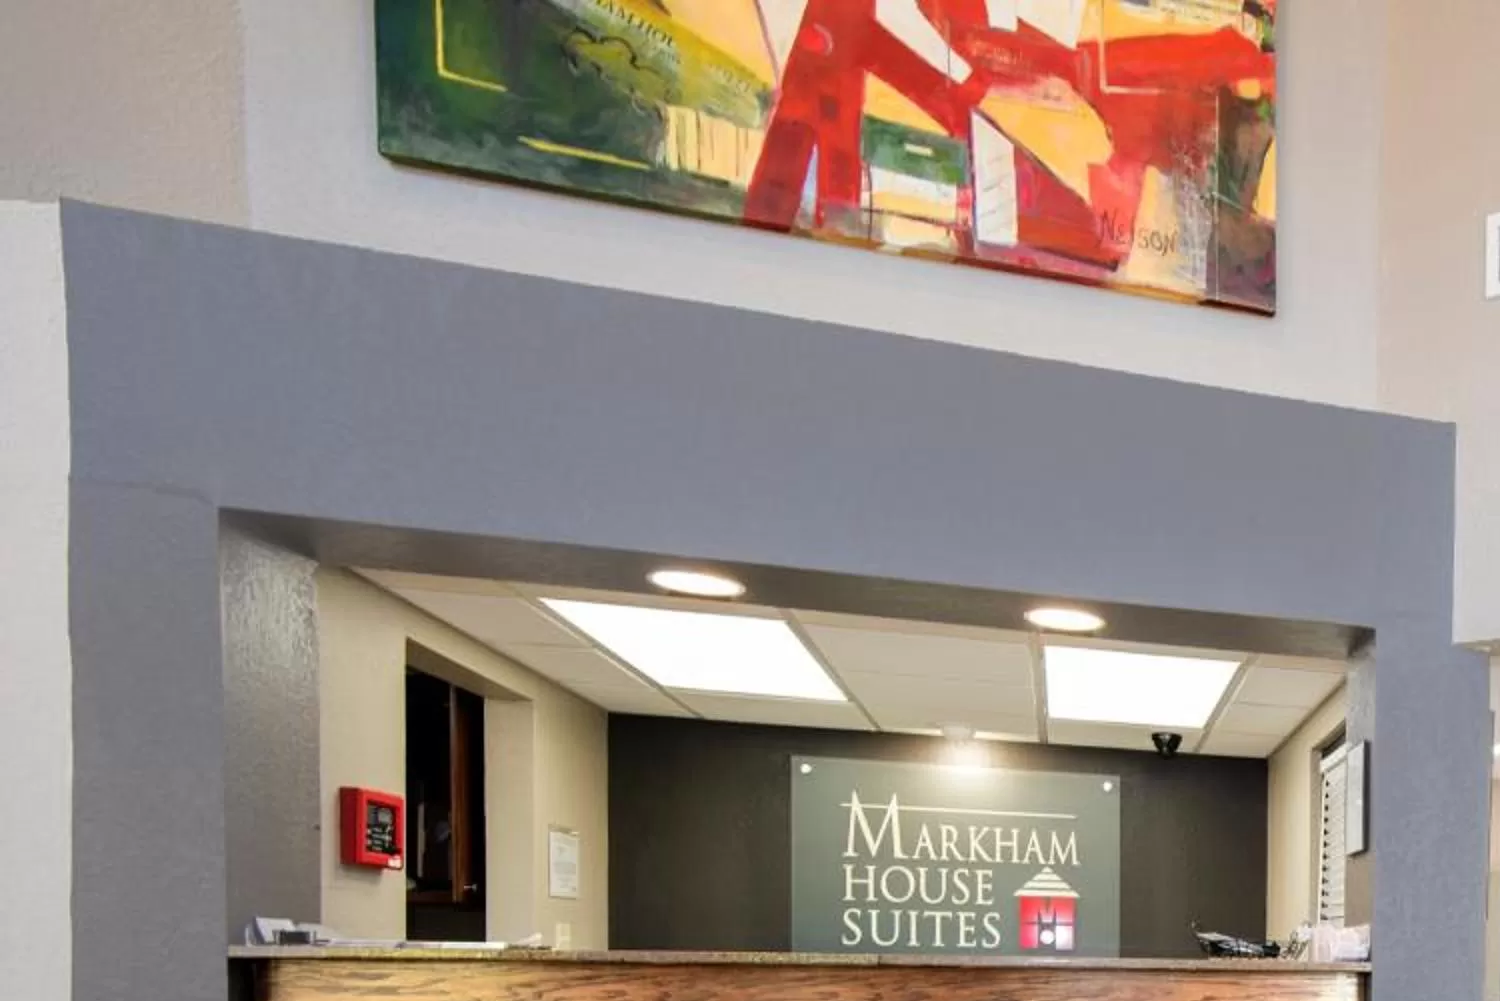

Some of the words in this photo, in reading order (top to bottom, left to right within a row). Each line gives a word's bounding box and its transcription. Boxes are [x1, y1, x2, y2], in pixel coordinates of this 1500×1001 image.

[841, 789, 1081, 866] MARKHAM
[841, 863, 995, 905] HOUSE
[841, 908, 1001, 949] SUITES
